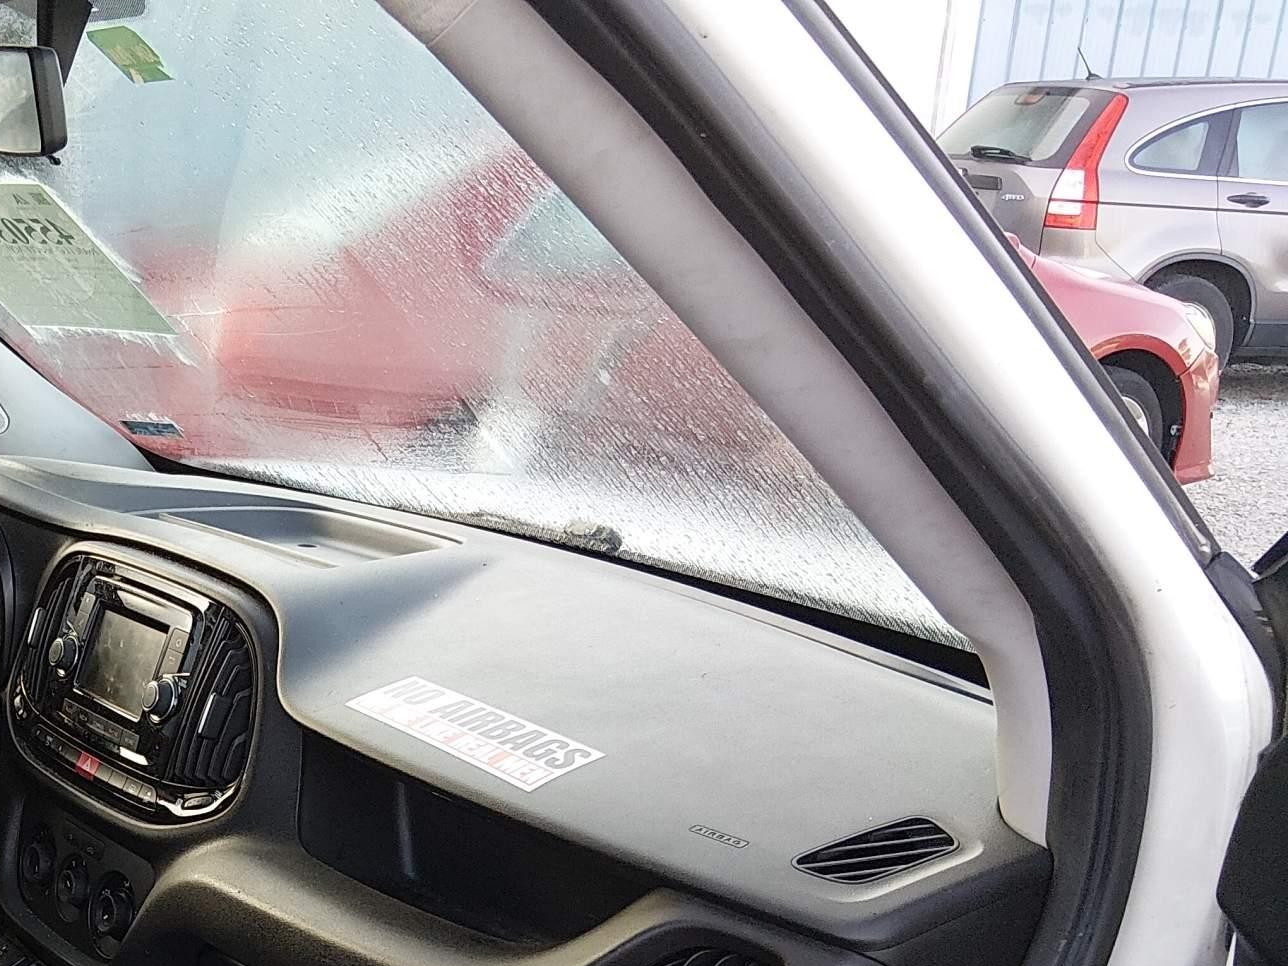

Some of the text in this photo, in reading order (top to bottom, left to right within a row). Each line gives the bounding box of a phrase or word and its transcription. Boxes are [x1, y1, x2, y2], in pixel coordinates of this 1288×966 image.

[383, 680, 446, 705] NO
[427, 699, 592, 770] AIRBAGS
[695, 827, 742, 846] AIRBAG
